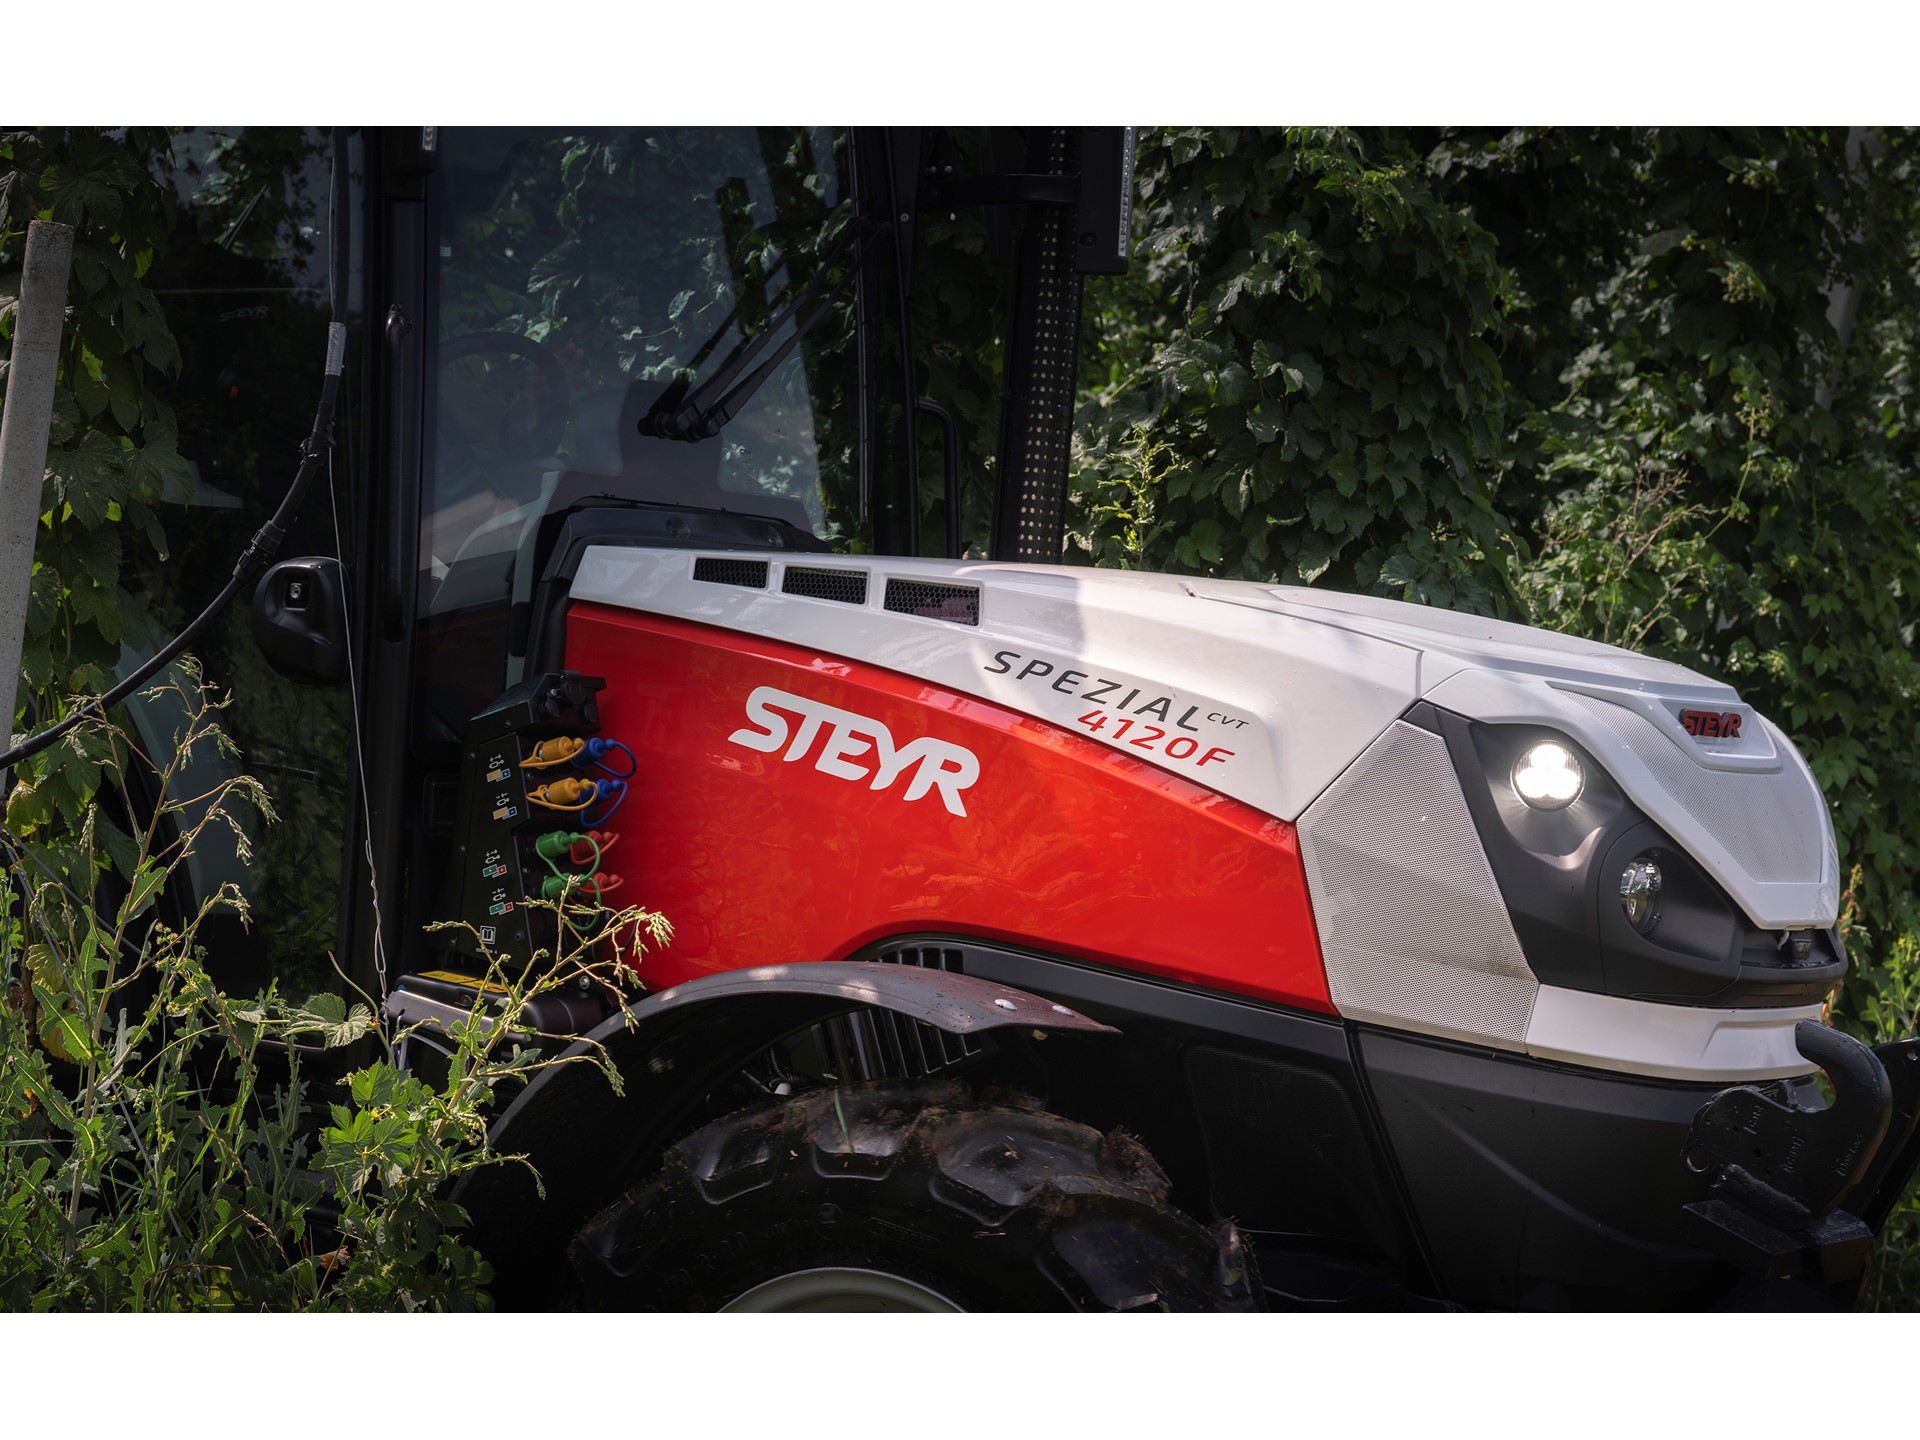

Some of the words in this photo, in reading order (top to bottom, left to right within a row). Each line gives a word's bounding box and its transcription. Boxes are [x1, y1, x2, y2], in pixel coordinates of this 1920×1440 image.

[984, 650, 1202, 732] SPEZIAL
[1206, 711, 1250, 730] CVT
[1680, 709, 1743, 738] STEYR
[728, 686, 980, 818] STEYR
[1077, 709, 1236, 767] 4120F
